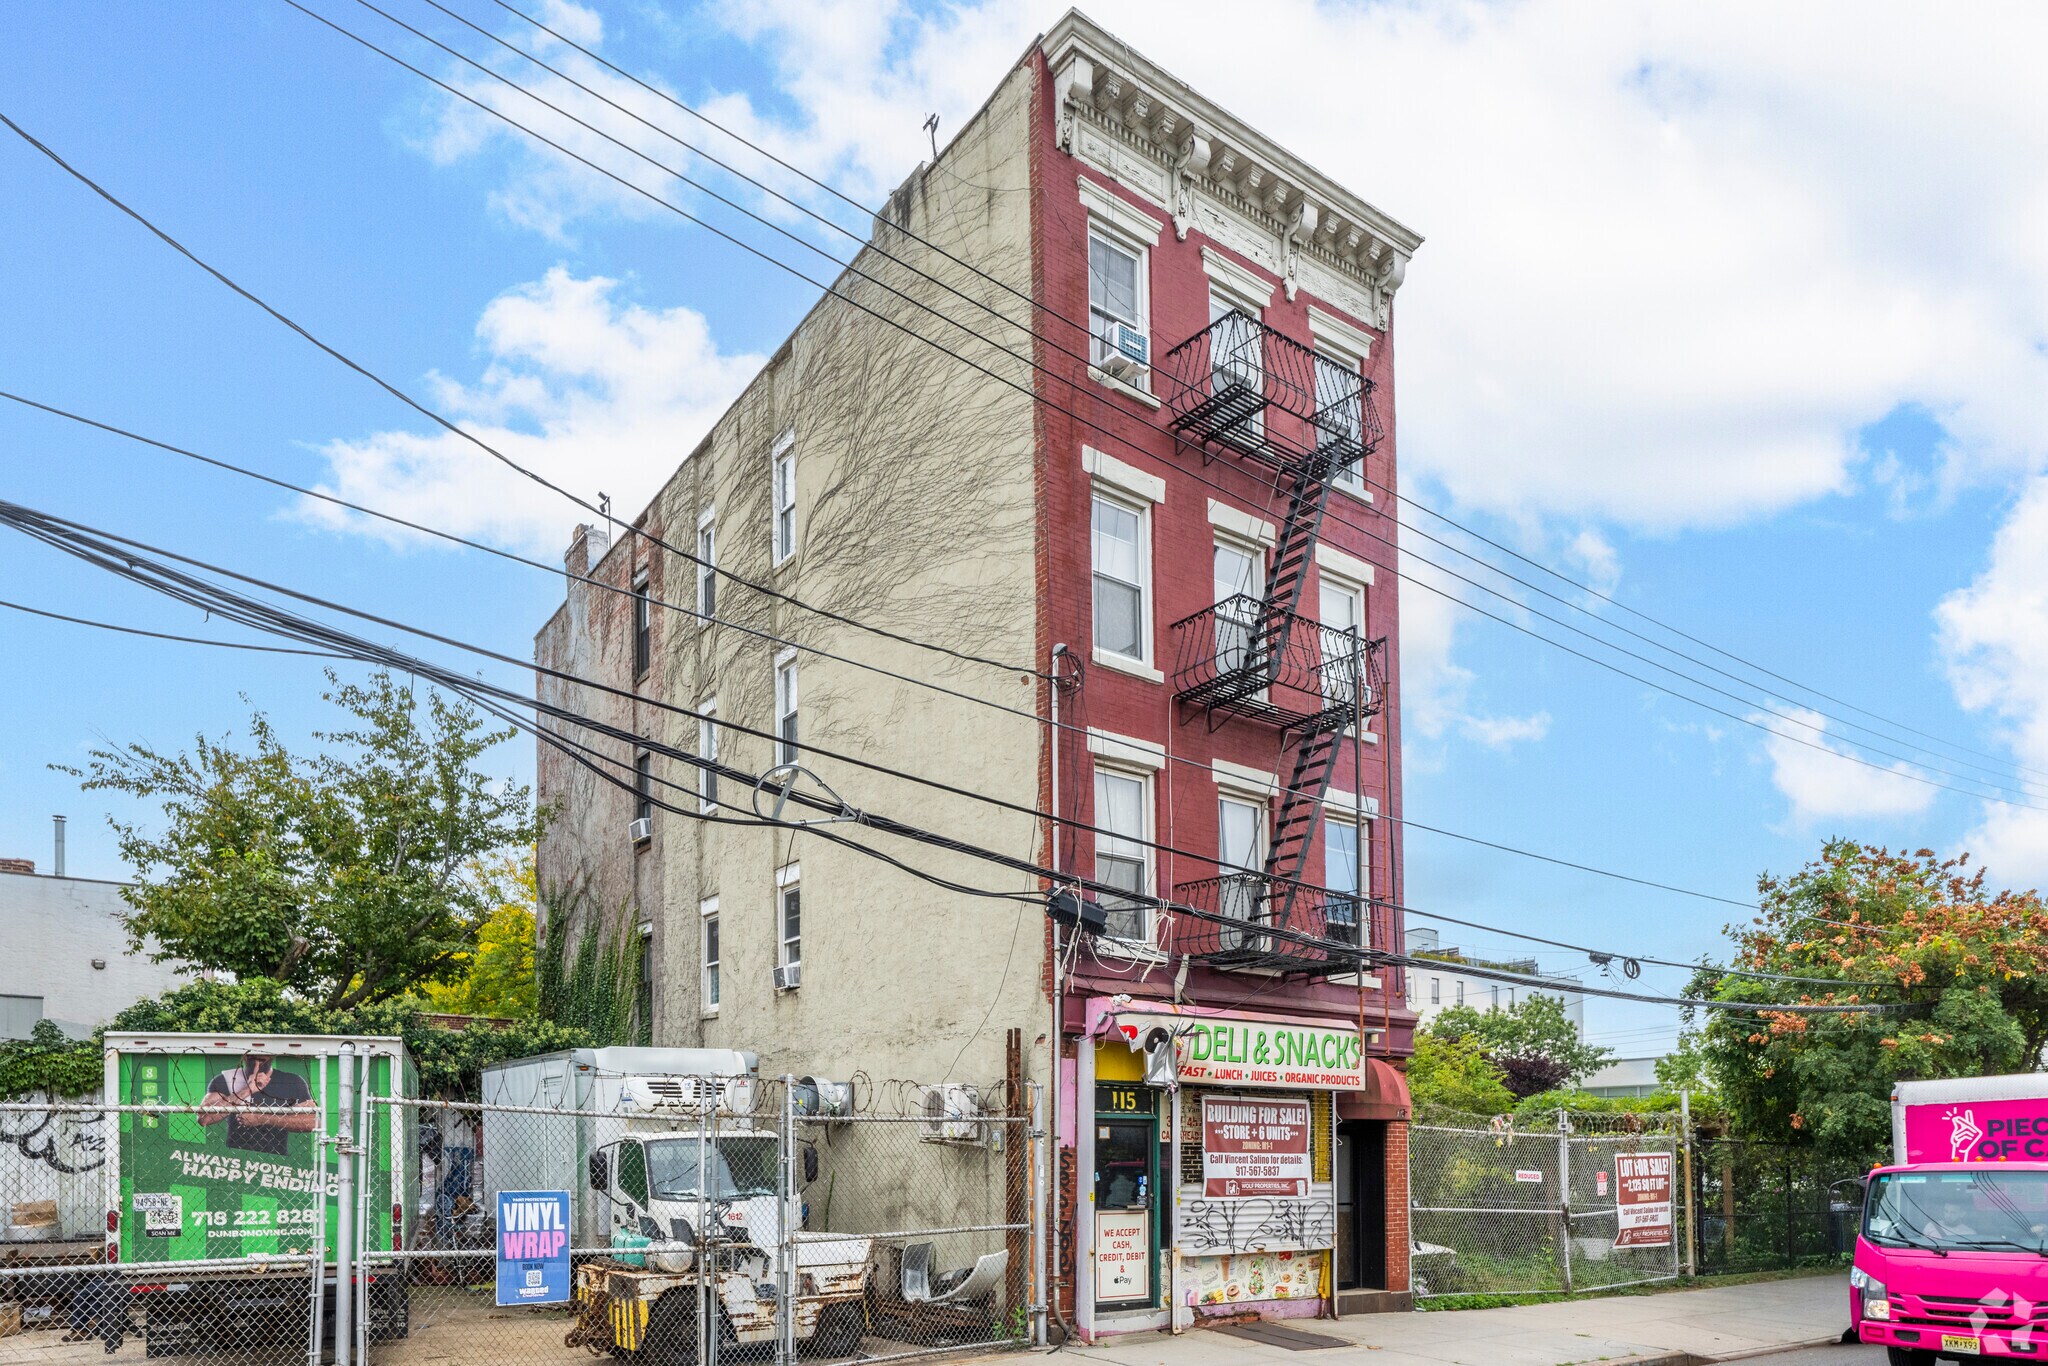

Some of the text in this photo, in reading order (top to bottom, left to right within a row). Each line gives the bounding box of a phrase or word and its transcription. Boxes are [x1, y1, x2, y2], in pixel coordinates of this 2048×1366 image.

[1193, 1023, 1361, 1070] DELI & SNACKS
[1215, 1069, 1243, 1081] LUNCH
[1250, 1070, 1278, 1082] JUICES
[1285, 1073, 1320, 1084] ORGANIC
[1320, 1074, 1360, 1086] PRODUCTS
[1112, 1091, 1137, 1110] 115
[1207, 1104, 1257, 1124] BUILDING
[1258, 1106, 1278, 1125] FOR
[1279, 1107, 1306, 1126] SALE!
[1251, 1128, 1258, 1137] +
[1258, 1125, 1265, 1140] 6
[1987, 1117, 2048, 1137] PIEC
[1978, 1138, 2048, 1158] OF C
[169, 1149, 241, 1169] ALWAYS
[245, 1160, 293, 1177] MOVE
[1210, 1154, 1303, 1165] Call Vincent Salino for details:
[1619, 1158, 1634, 1177] LOT
[1633, 1158, 1650, 1177] FOR
[1649, 1157, 1669, 1176] SALE!
[182, 1162, 257, 1185] HAPPY
[1235, 1166, 1280, 1177] 917-567-5837
[1641, 1178, 1650, 1192] SQ
[1650, 1178, 1656, 1190] FT
[191, 1210, 228, 1226] 718
[233, 1210, 271, 1225] 222
[503, 1202, 565, 1232] VINYL
[727, 1212, 743, 1221] 1612
[207, 1228, 314, 1239] DUMBOMOVING.COM
[1104, 1228, 1140, 1237] WE ACCEPT
[503, 1231, 566, 1260] WRAP
[1112, 1241, 1133, 1250] CASH,
[1099, 1252, 1146, 1262] CREDIT, DEBIT
[1120, 1265, 1125, 1273] &
[1119, 1276, 1132, 1285] Pay
